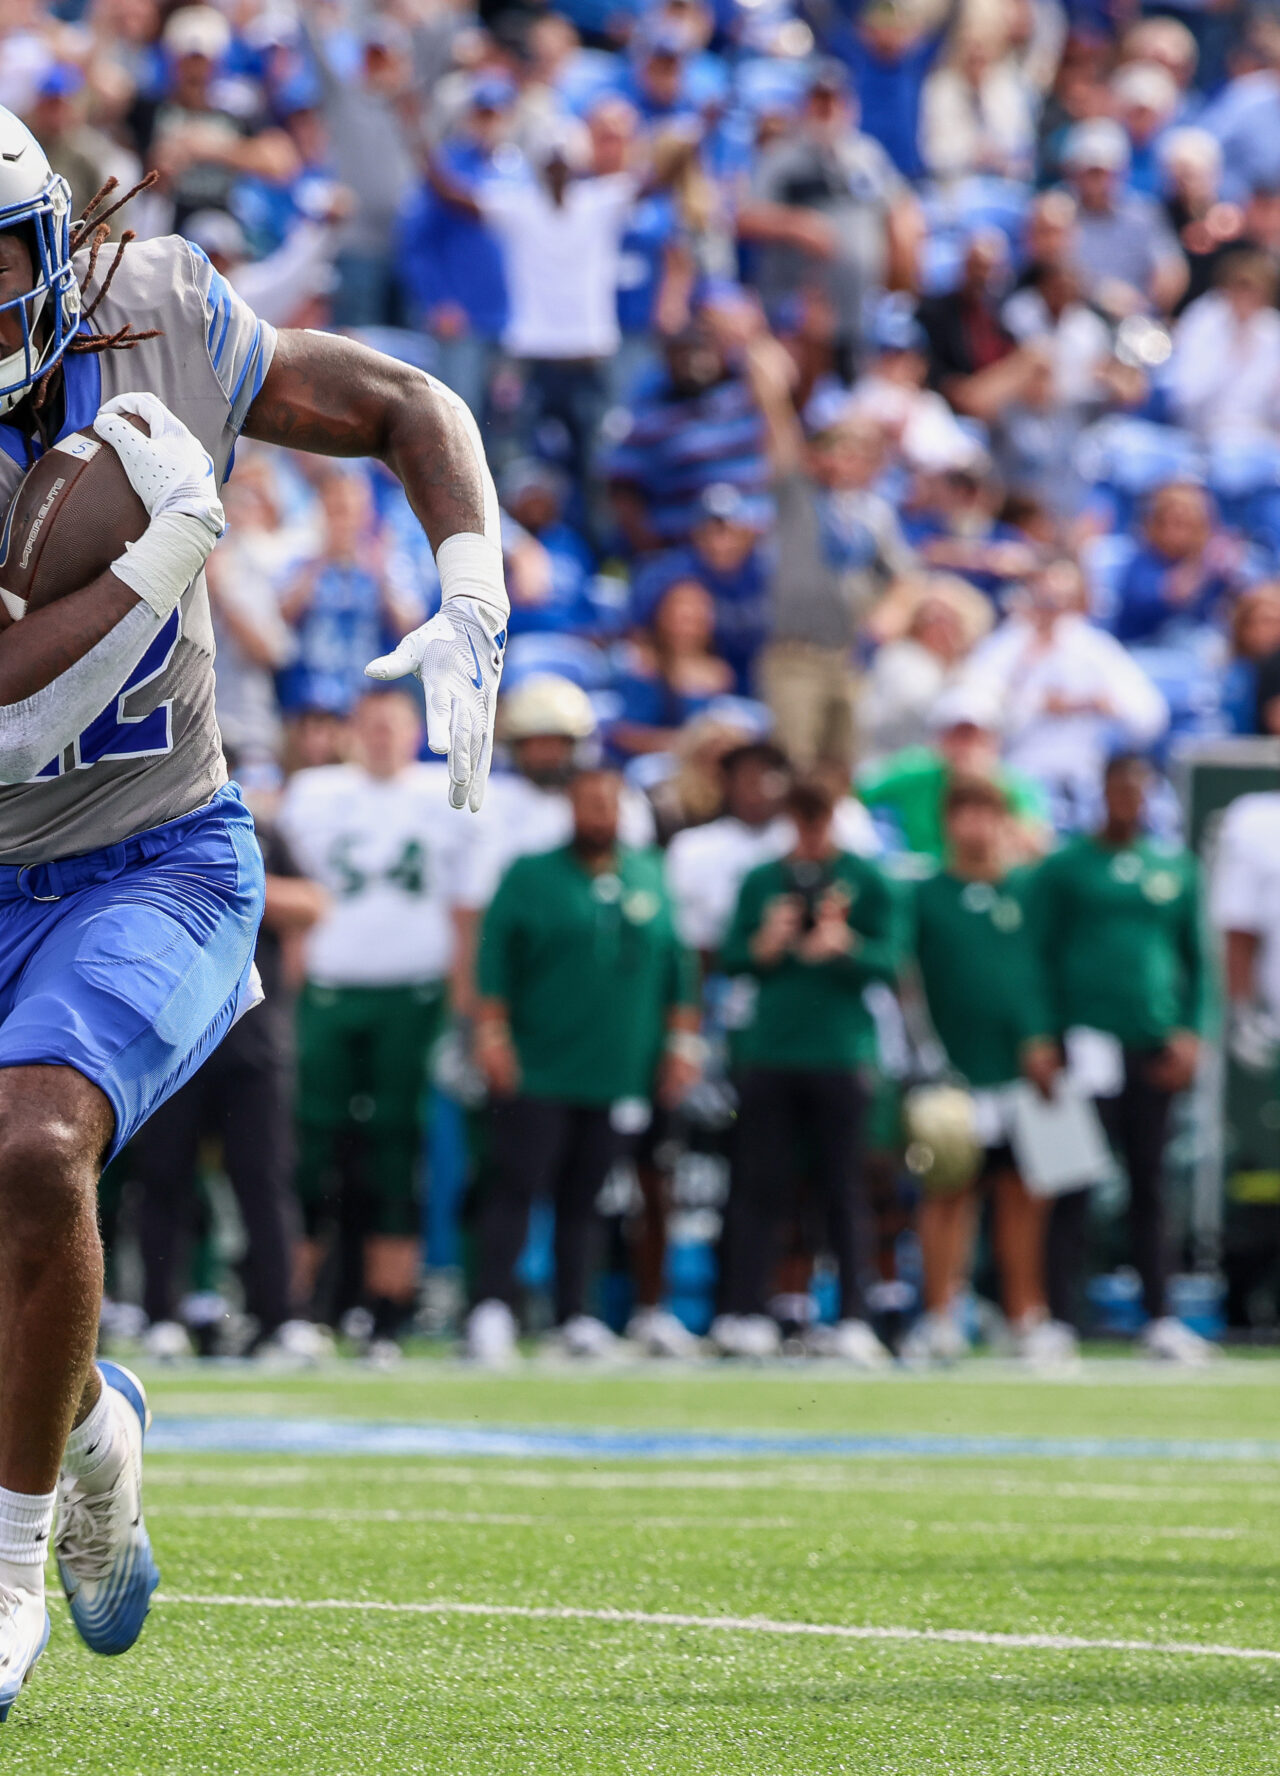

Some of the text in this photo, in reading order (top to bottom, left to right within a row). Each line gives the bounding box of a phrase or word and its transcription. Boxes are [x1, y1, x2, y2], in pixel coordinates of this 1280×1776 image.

[71, 441, 94, 454] 5
[19, 477, 66, 569] VAPOR ELITE
